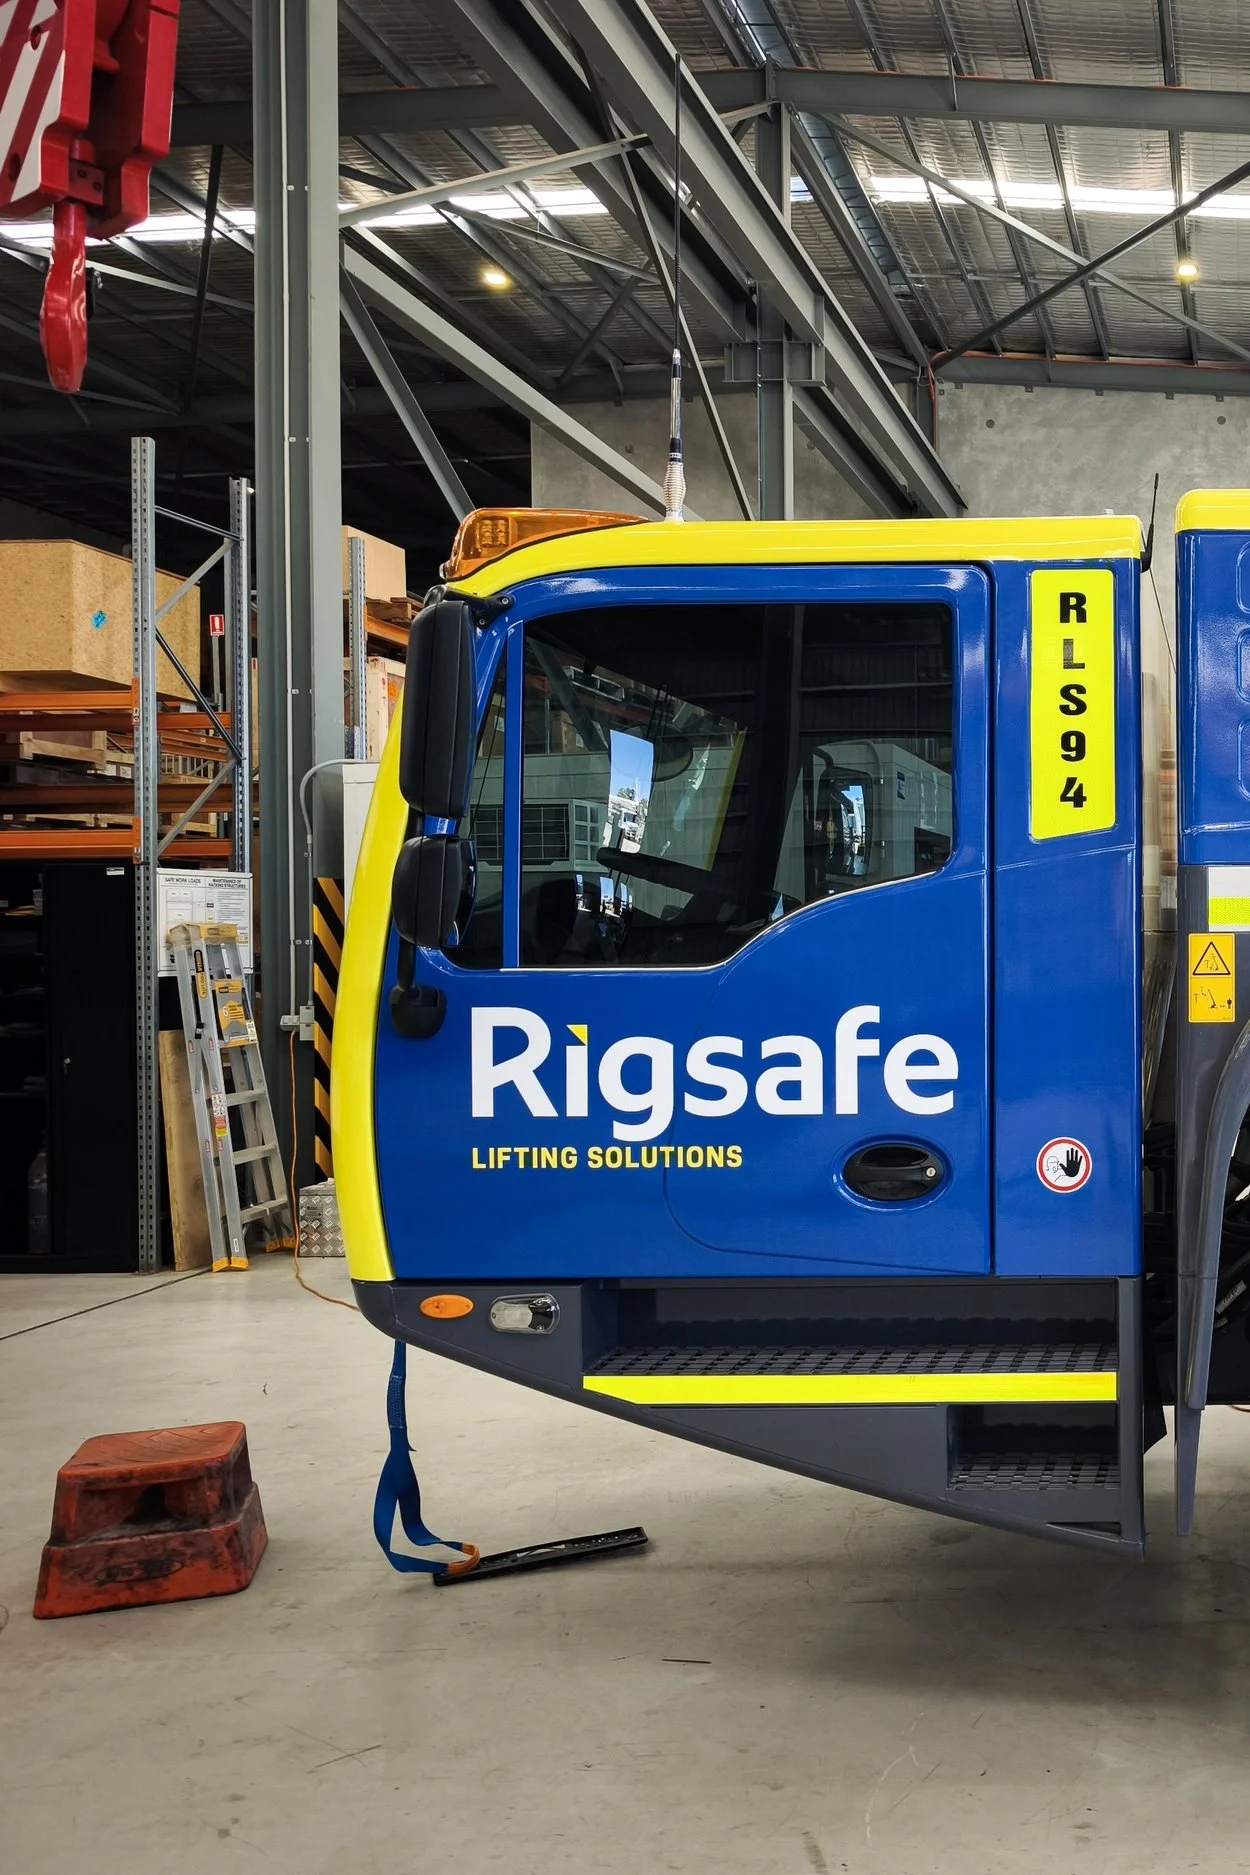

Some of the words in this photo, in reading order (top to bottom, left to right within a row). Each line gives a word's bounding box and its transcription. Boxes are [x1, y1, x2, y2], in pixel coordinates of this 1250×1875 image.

[1059, 592, 1088, 808] RLS94
[222, 1006, 229, 1017] 6
[471, 1004, 959, 1141] Rigsafe
[472, 1147, 577, 1169] LIFTING
[588, 1146, 743, 1168] SOLUTIONS
